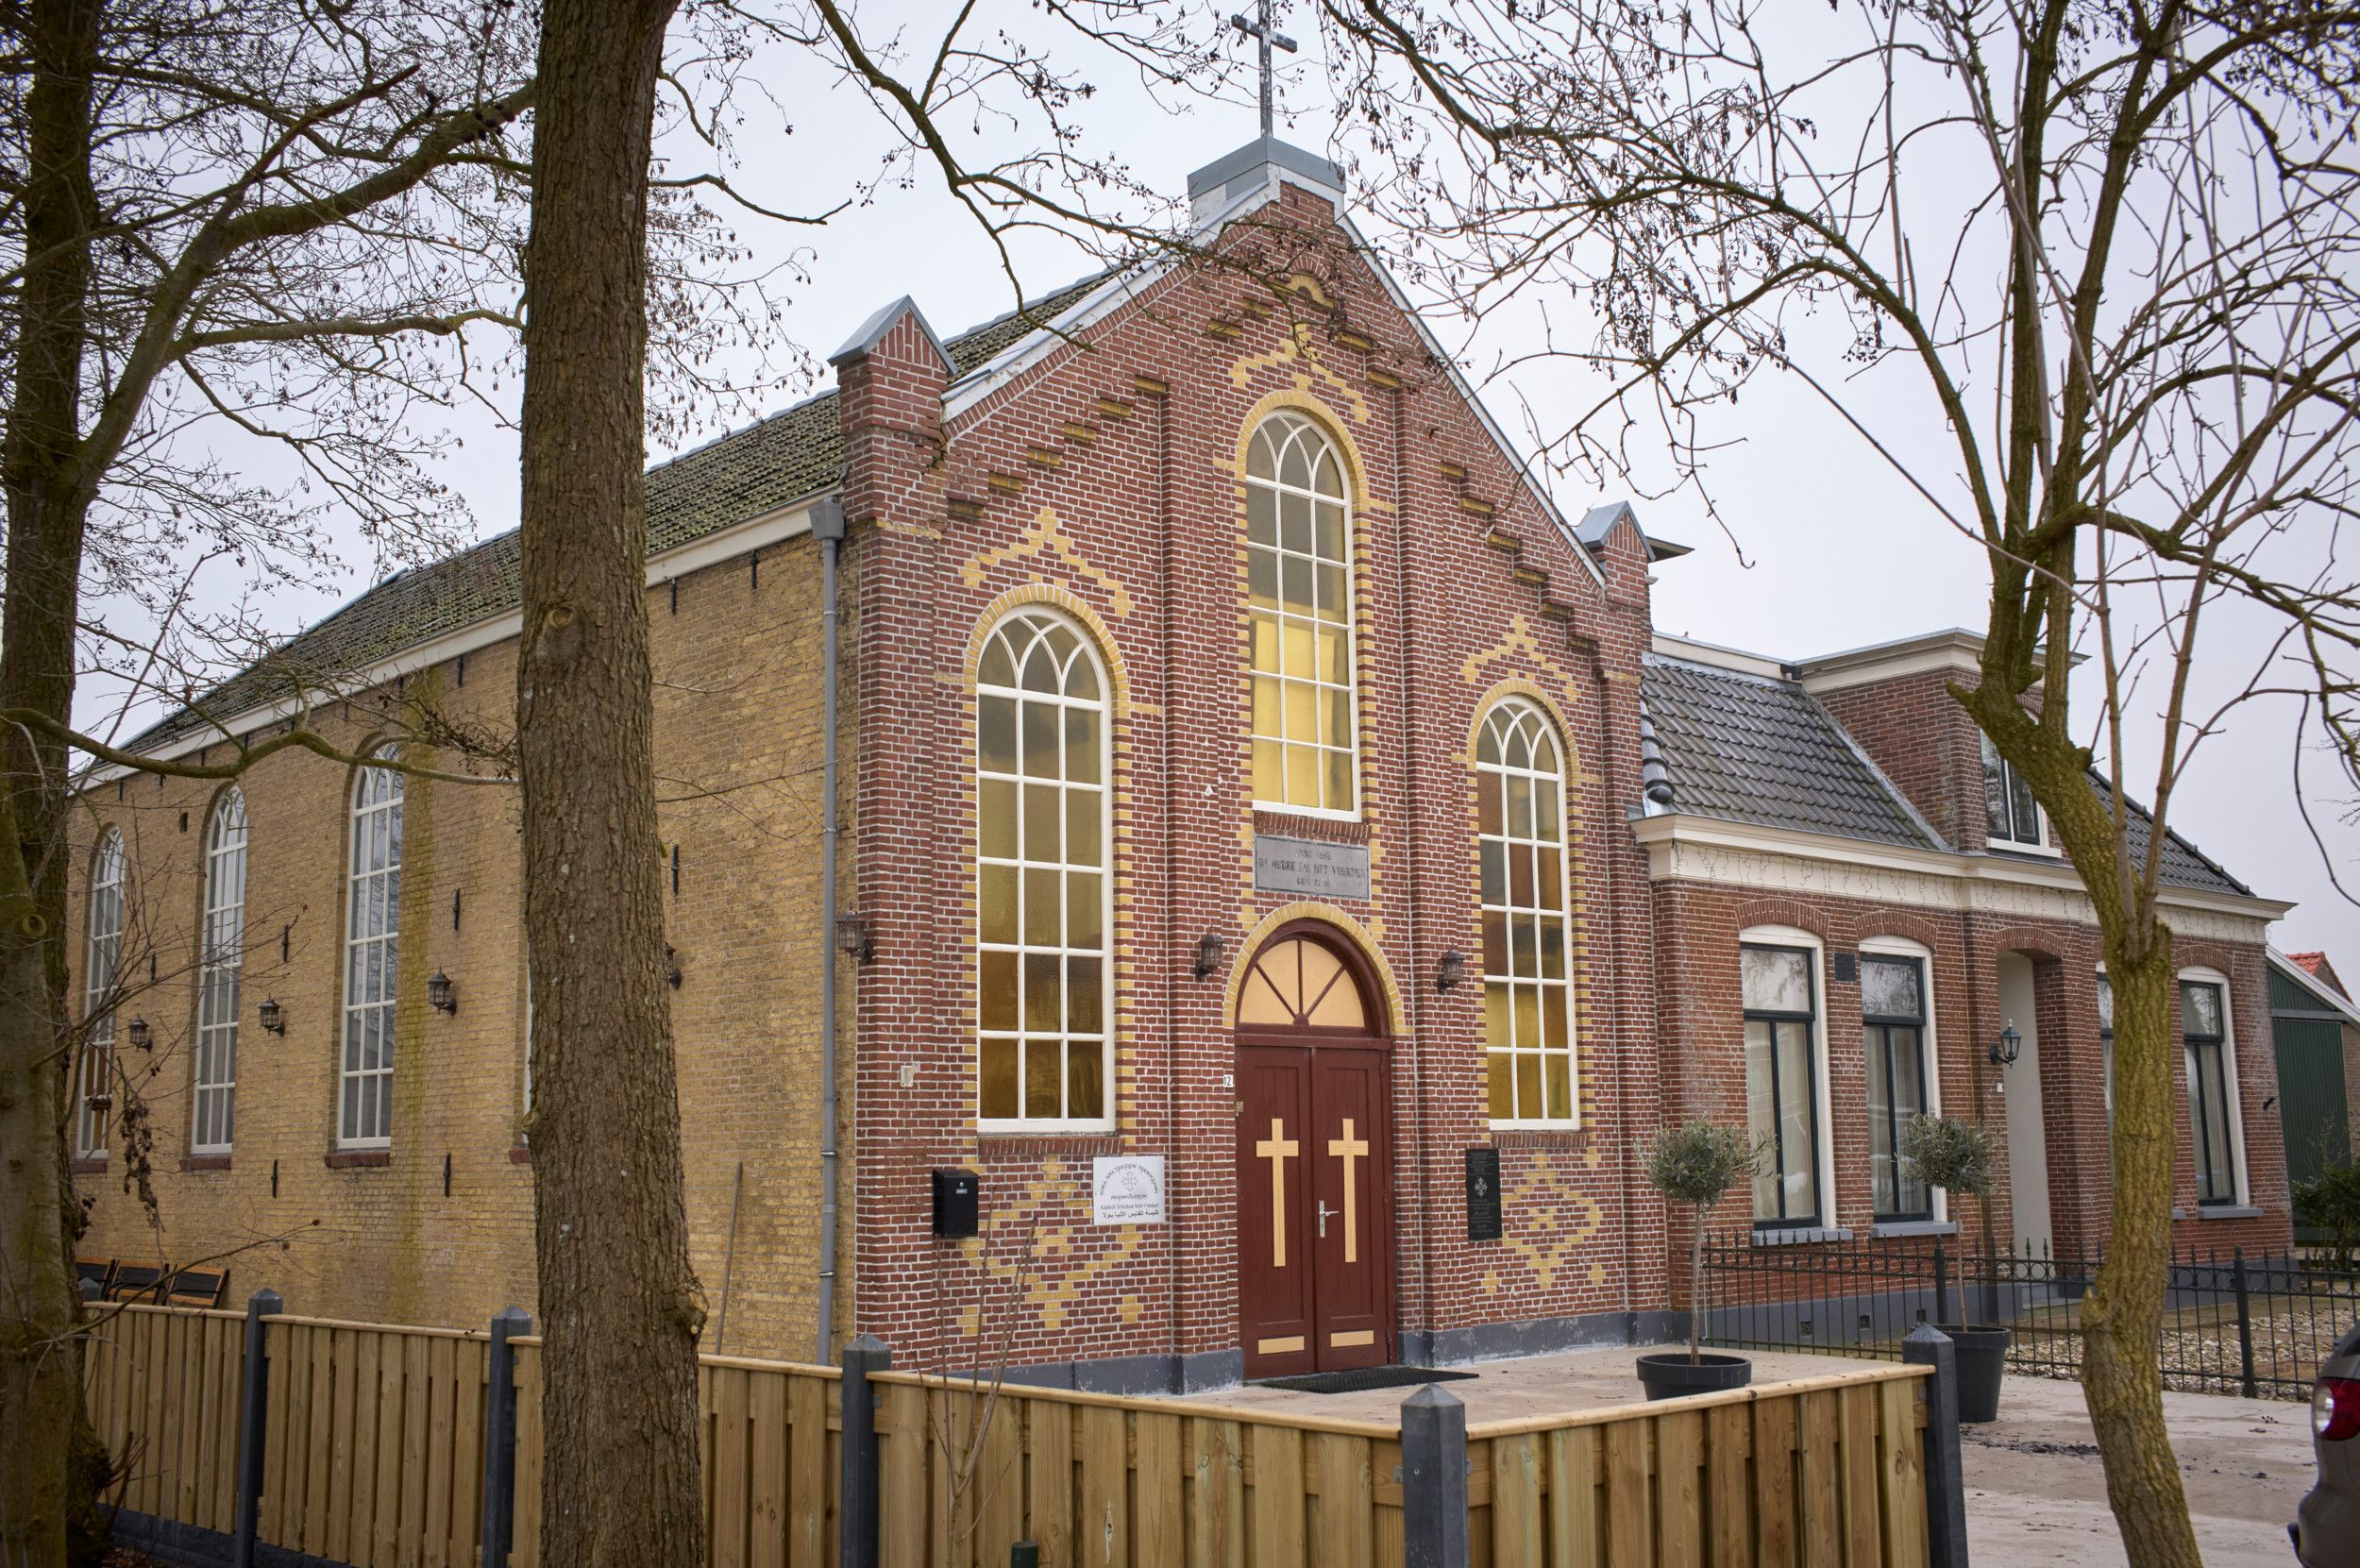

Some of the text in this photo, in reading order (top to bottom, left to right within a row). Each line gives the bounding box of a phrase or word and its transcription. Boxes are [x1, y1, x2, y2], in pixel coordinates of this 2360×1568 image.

[1272, 860, 1295, 871] HEERE
[1314, 864, 1328, 874] HET
[1223, 1076, 1232, 1086] 12
